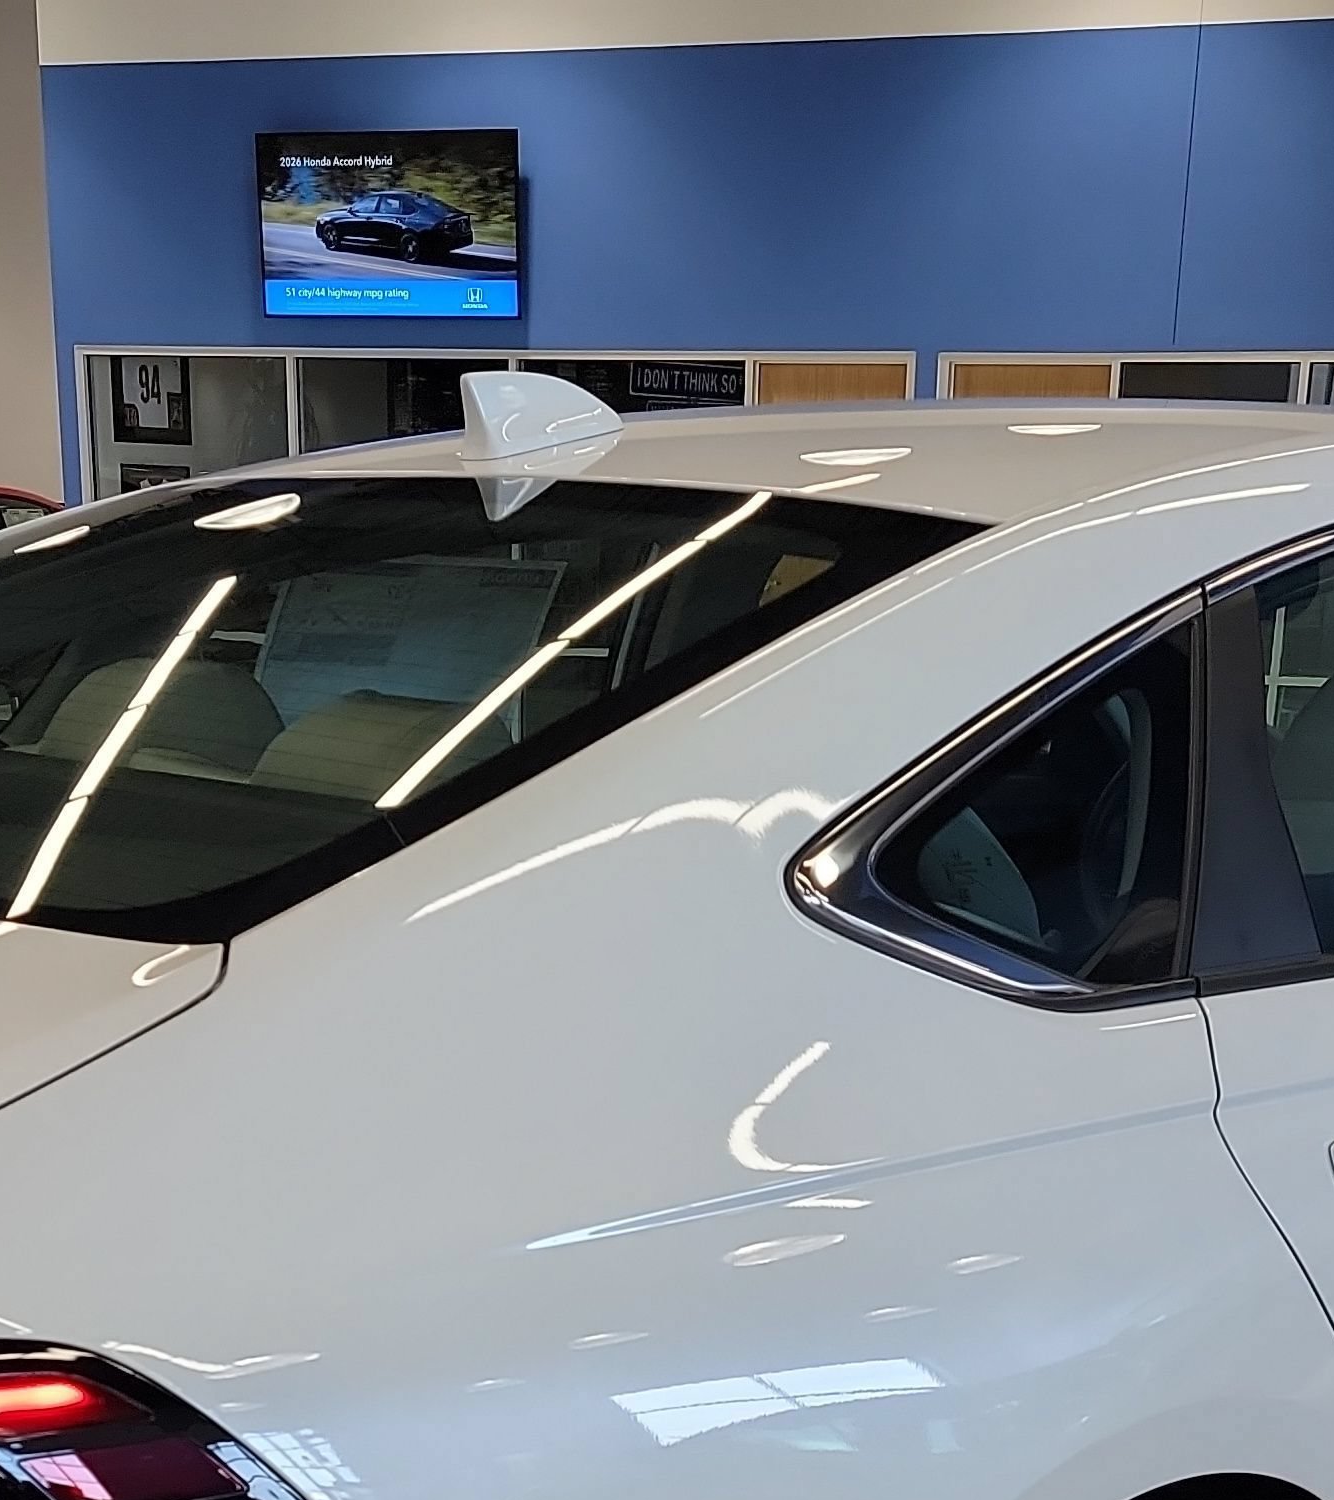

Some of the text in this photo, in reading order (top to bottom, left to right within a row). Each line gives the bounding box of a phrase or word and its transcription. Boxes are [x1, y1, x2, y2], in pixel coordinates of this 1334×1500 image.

[279, 155, 393, 168] 2026 Honda Accord Hybrid
[285, 287, 409, 300] 51 city/44 highway mpg rating
[138, 364, 161, 404] 94
[637, 367, 737, 394] I DON'T THINK SO
